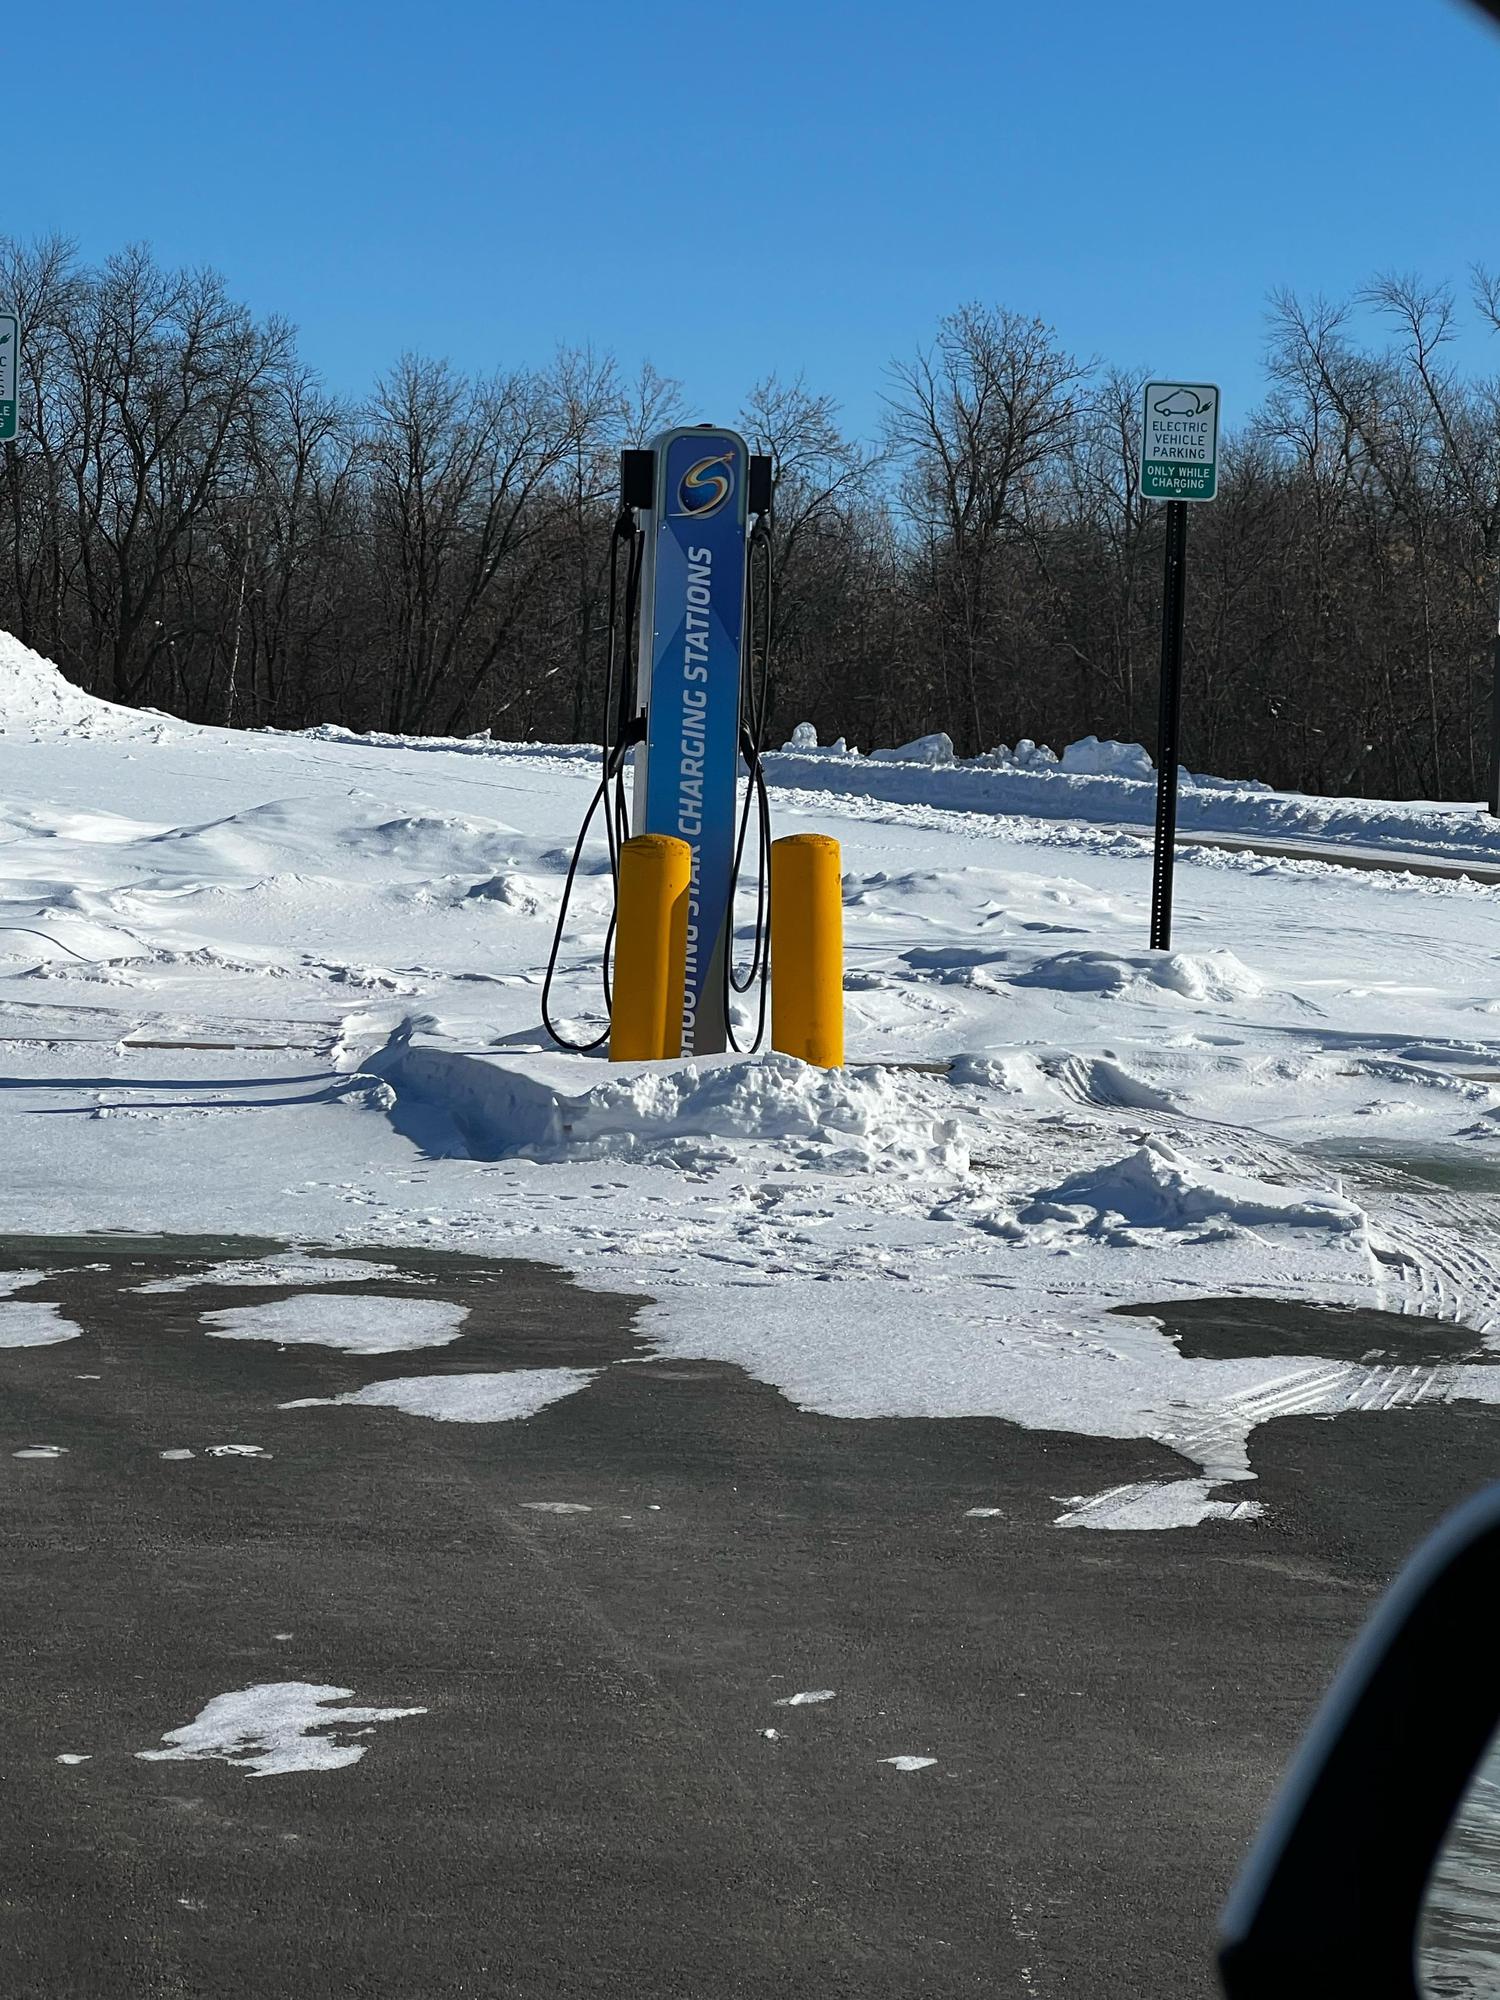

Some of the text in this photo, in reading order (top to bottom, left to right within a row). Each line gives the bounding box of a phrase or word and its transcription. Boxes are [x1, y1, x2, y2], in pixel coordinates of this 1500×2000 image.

[1152, 421, 1208, 433] ELECTRIC
[1155, 434, 1205, 446] VEHICLE
[1153, 446, 1205, 459] PARKING
[1147, 465, 1210, 478] ONLY WHILE
[1152, 477, 1205, 489] CHARGING
[683, 546, 712, 683] STATIONS
[678, 689, 707, 836] CHARGING
